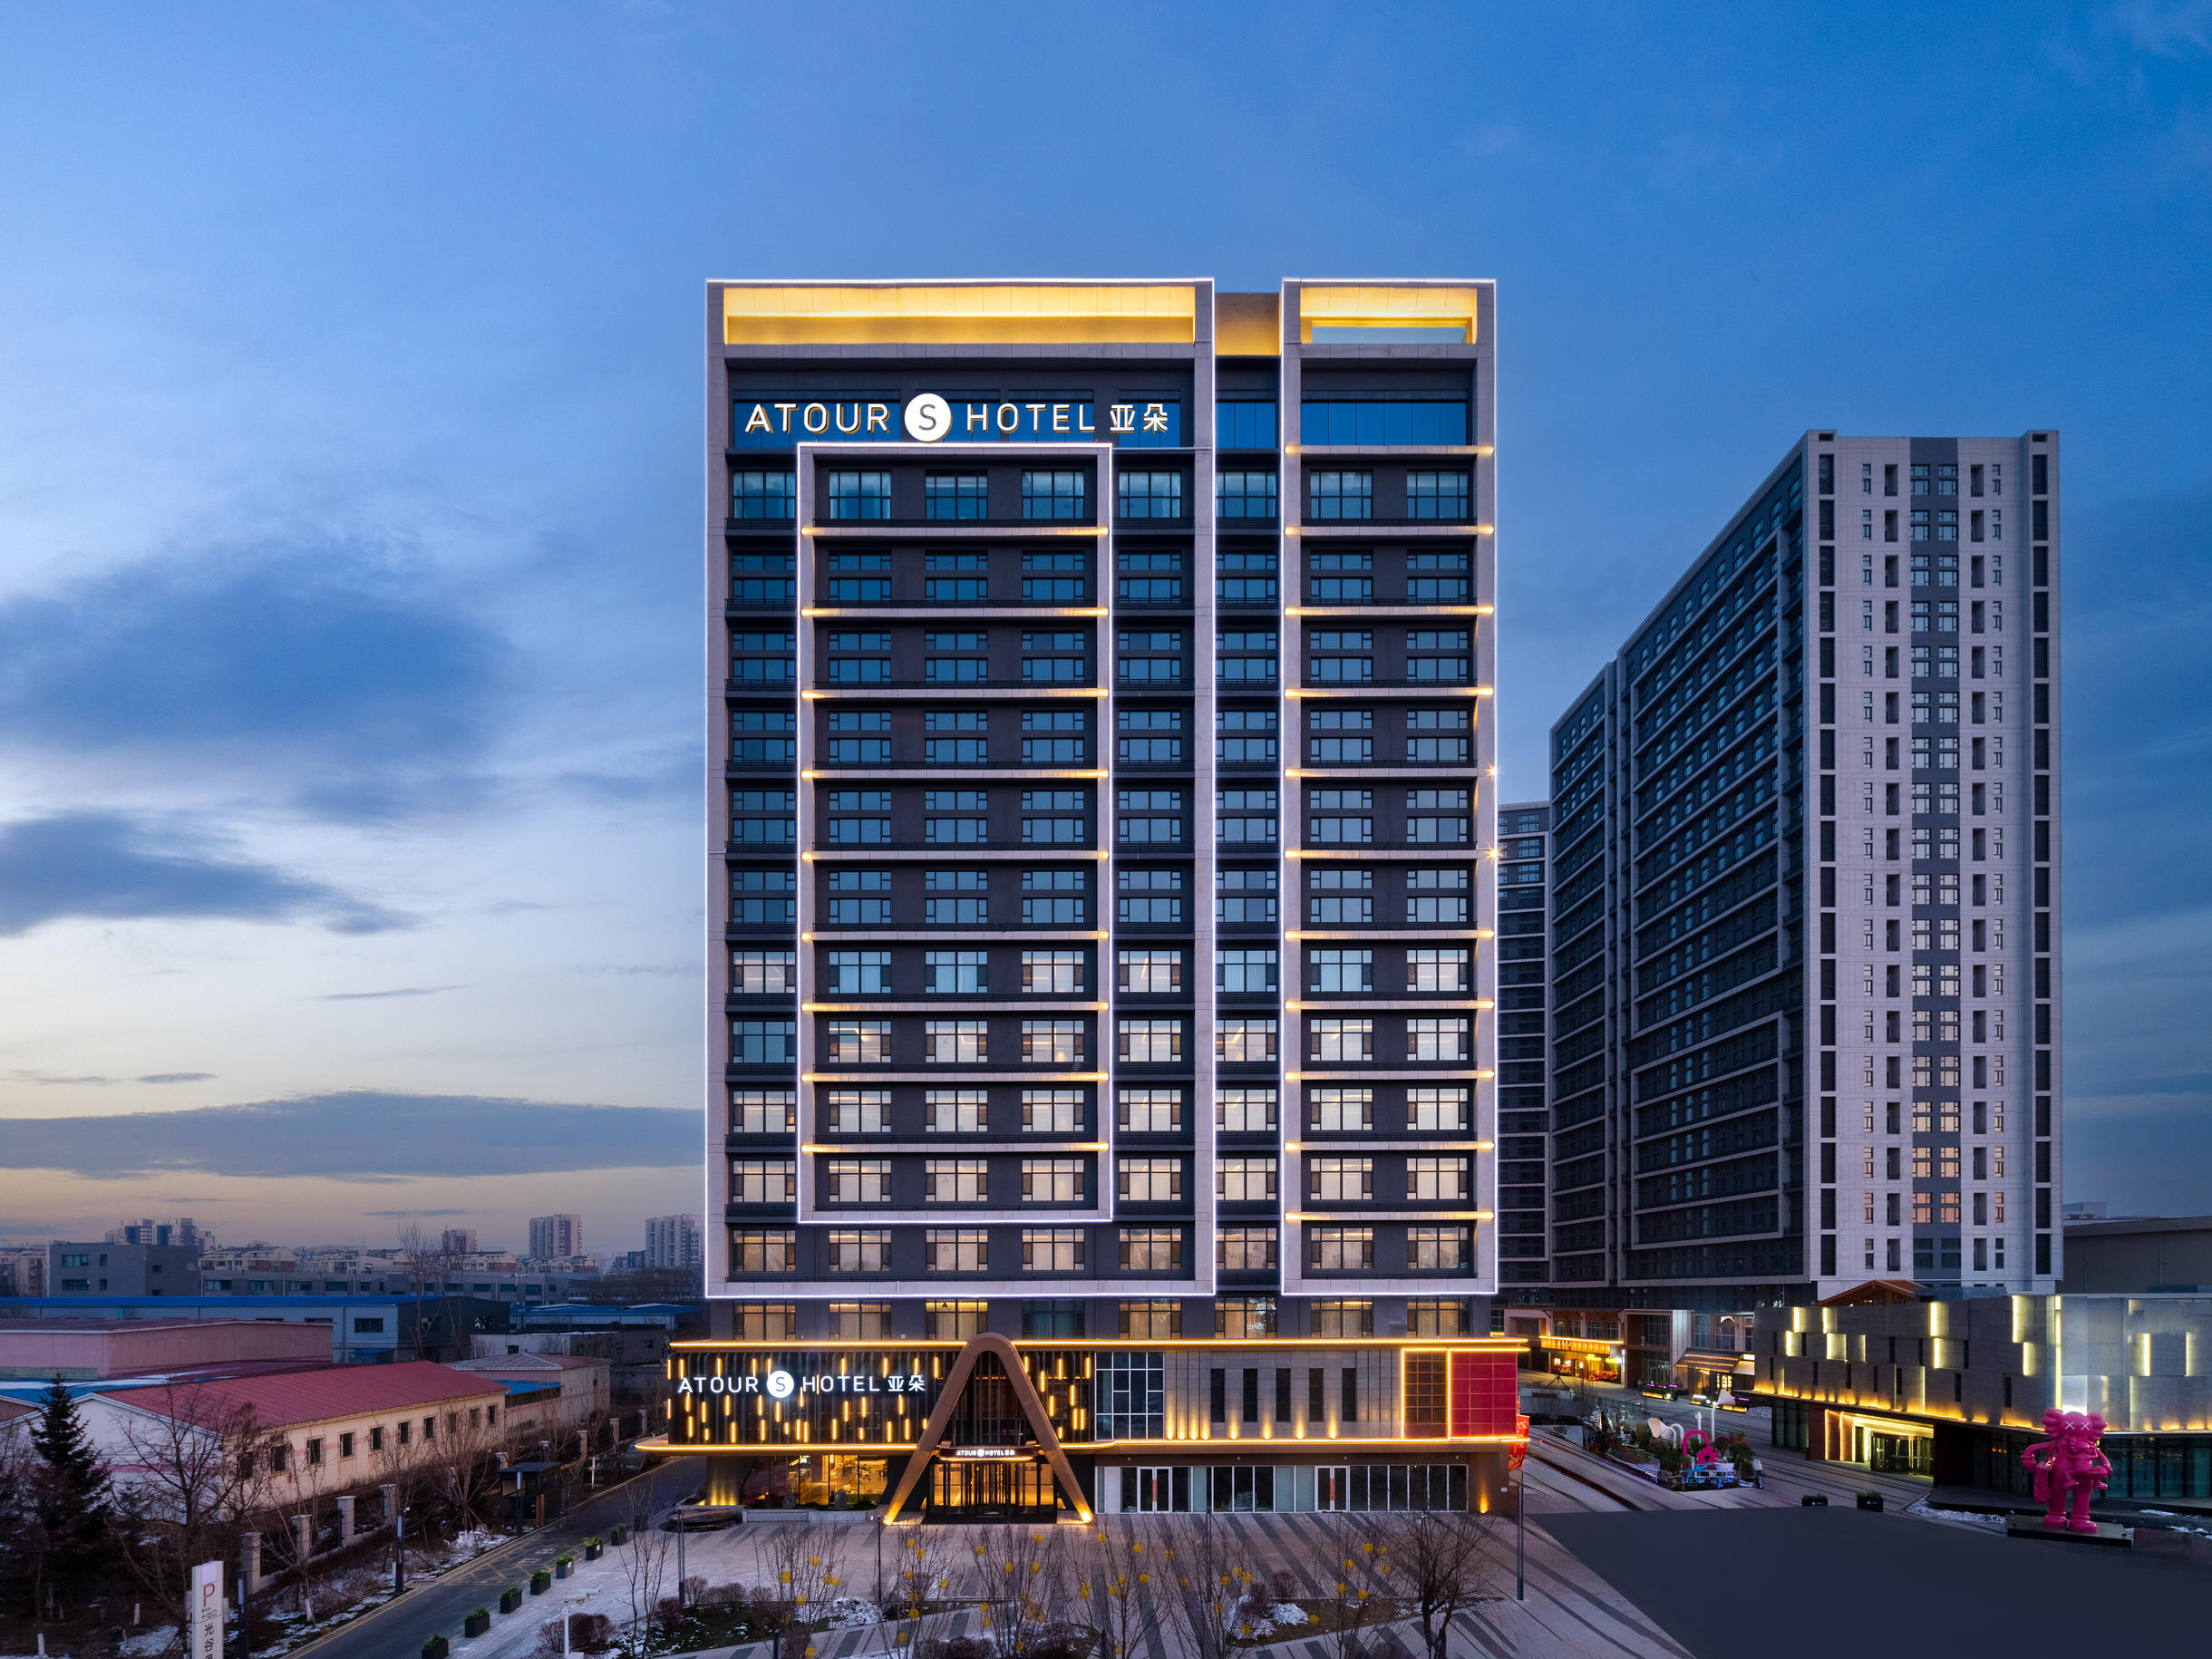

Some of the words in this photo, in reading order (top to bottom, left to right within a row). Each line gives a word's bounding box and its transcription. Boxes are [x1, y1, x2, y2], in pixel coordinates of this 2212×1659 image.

[745, 403, 889, 433] ATOUR
[966, 403, 1095, 433] HOTEL
[1110, 403, 1169, 433] 亚朵
[677, 1376, 759, 1393] ATOUR
[802, 1375, 880, 1392] HOTEL
[888, 1374, 925, 1392] 亚朵
[203, 1583, 216, 1607] P
